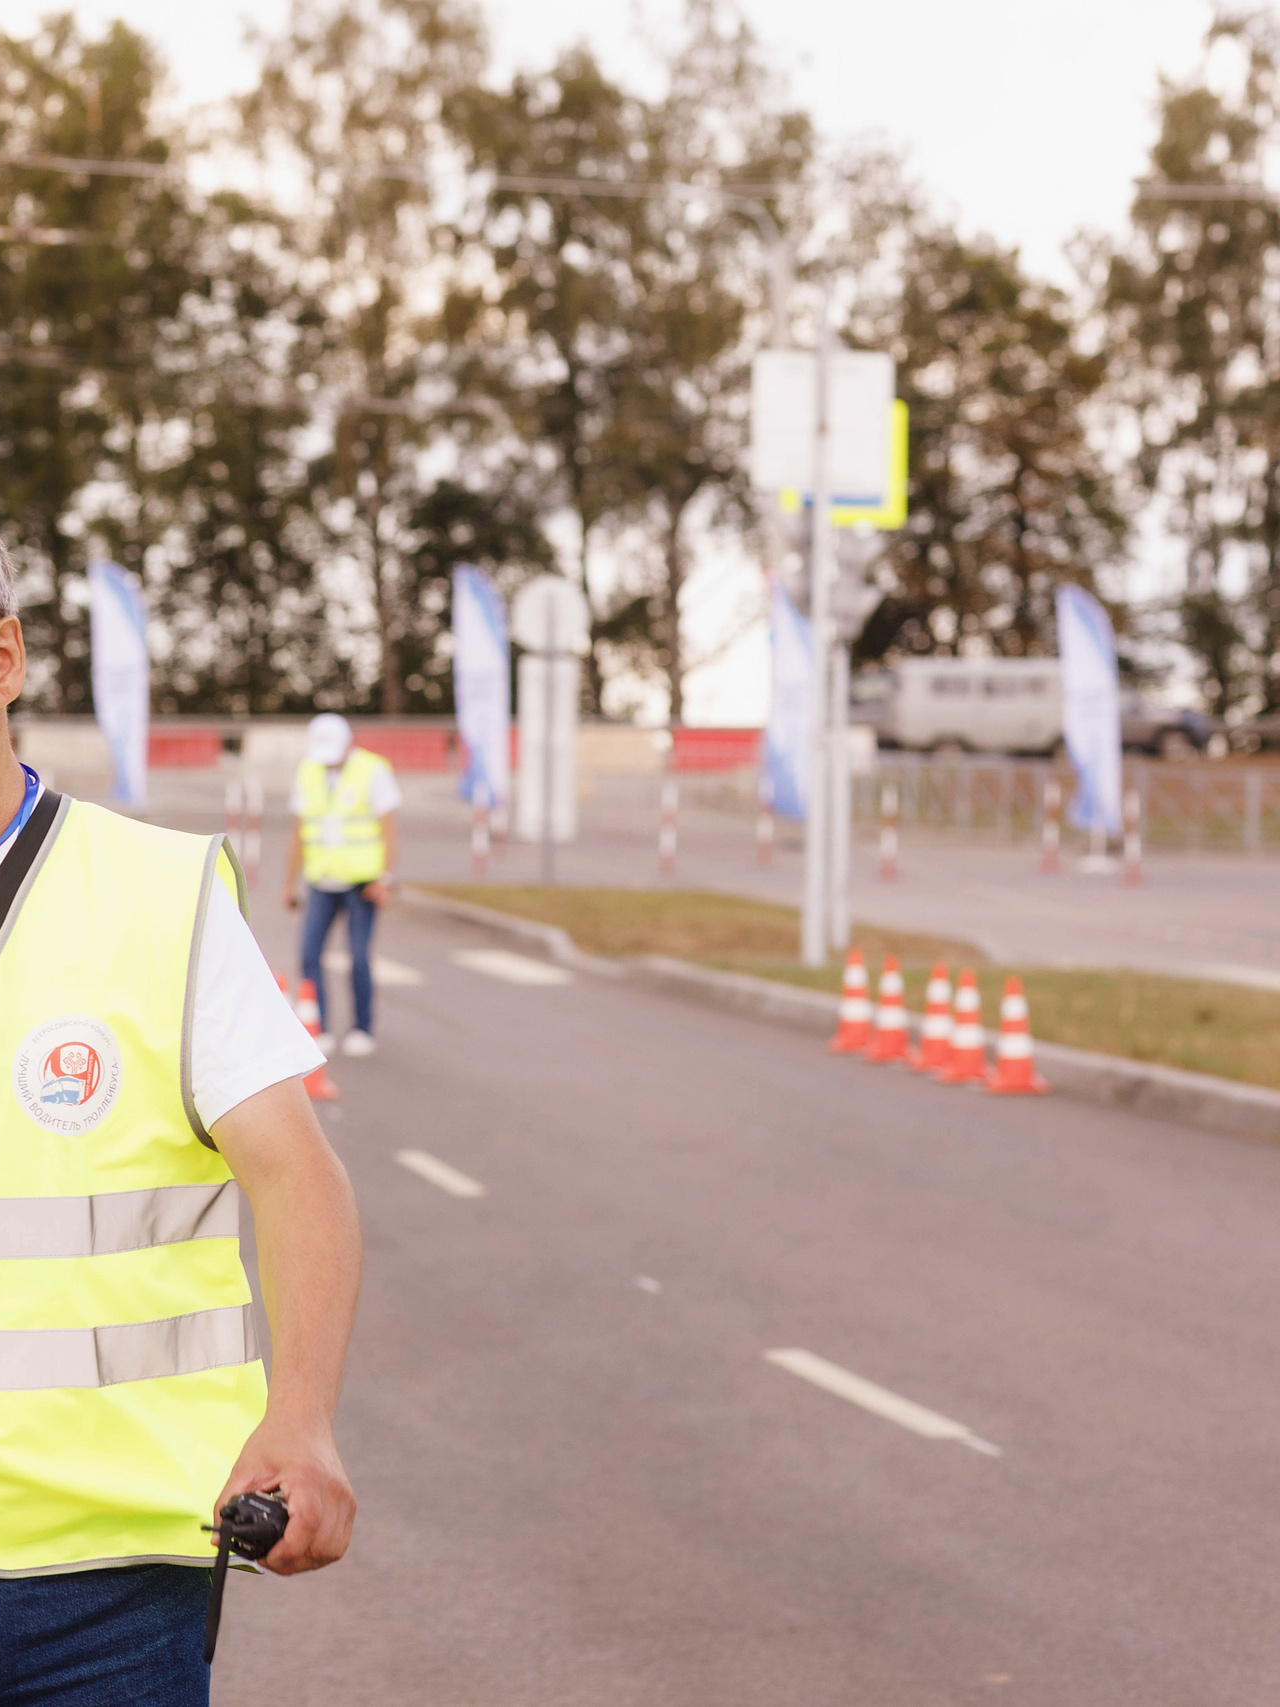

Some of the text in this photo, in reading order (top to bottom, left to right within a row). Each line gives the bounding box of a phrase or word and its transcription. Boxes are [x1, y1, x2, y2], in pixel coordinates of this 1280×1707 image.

[32, 1020, 112, 1048] ВСЕРОССИЙСКИЙ КОНКУРС
[29, 1102, 82, 1132] ВОДИТЕЛЬ
